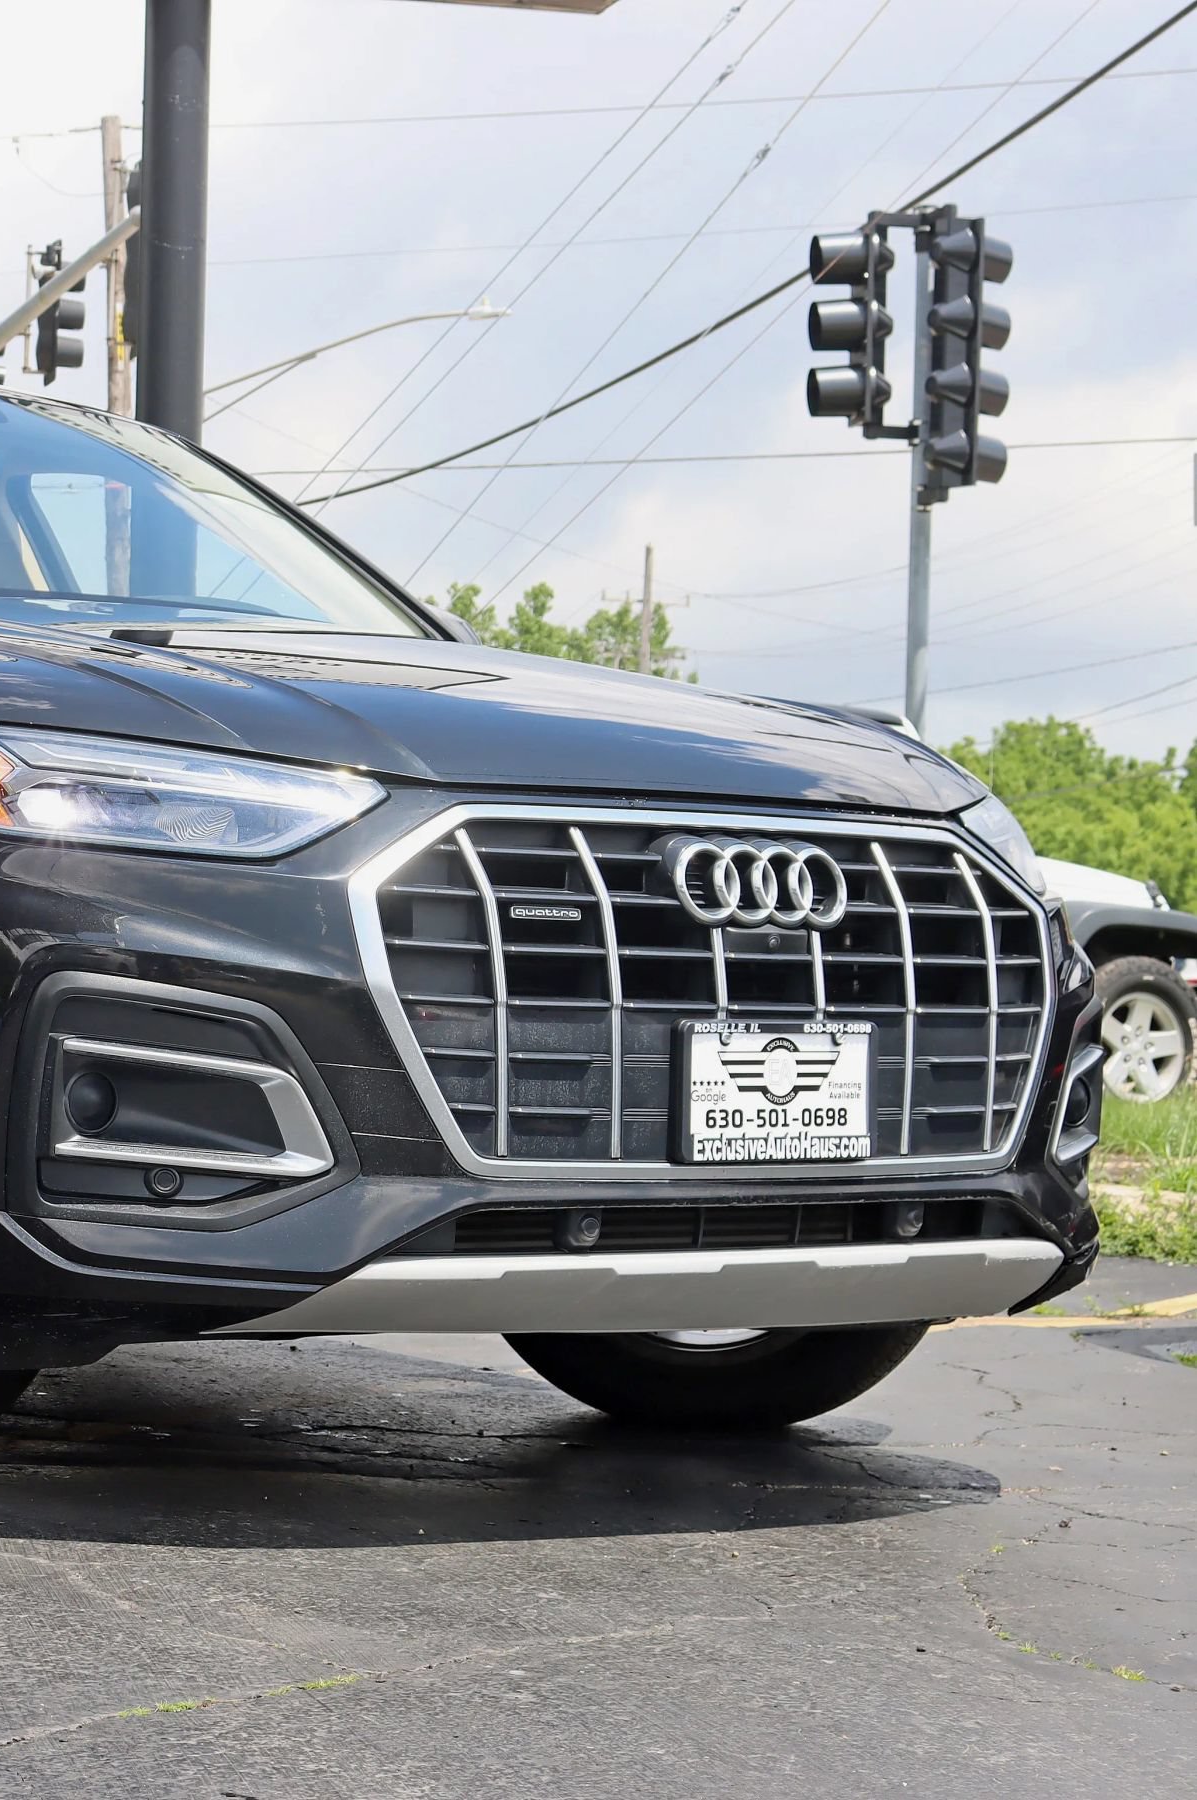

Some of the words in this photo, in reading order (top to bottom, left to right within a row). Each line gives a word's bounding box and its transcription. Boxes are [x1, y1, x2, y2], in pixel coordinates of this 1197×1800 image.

[515, 908, 579, 918] quattro
[749, 1023, 761, 1033] IL
[828, 1081, 862, 1091] Financing
[691, 1089, 727, 1105] Google
[829, 1091, 861, 1099] Available
[705, 1107, 848, 1129] 630-501-0698
[693, 1132, 871, 1161] ExclusiveAutoHaus.com
